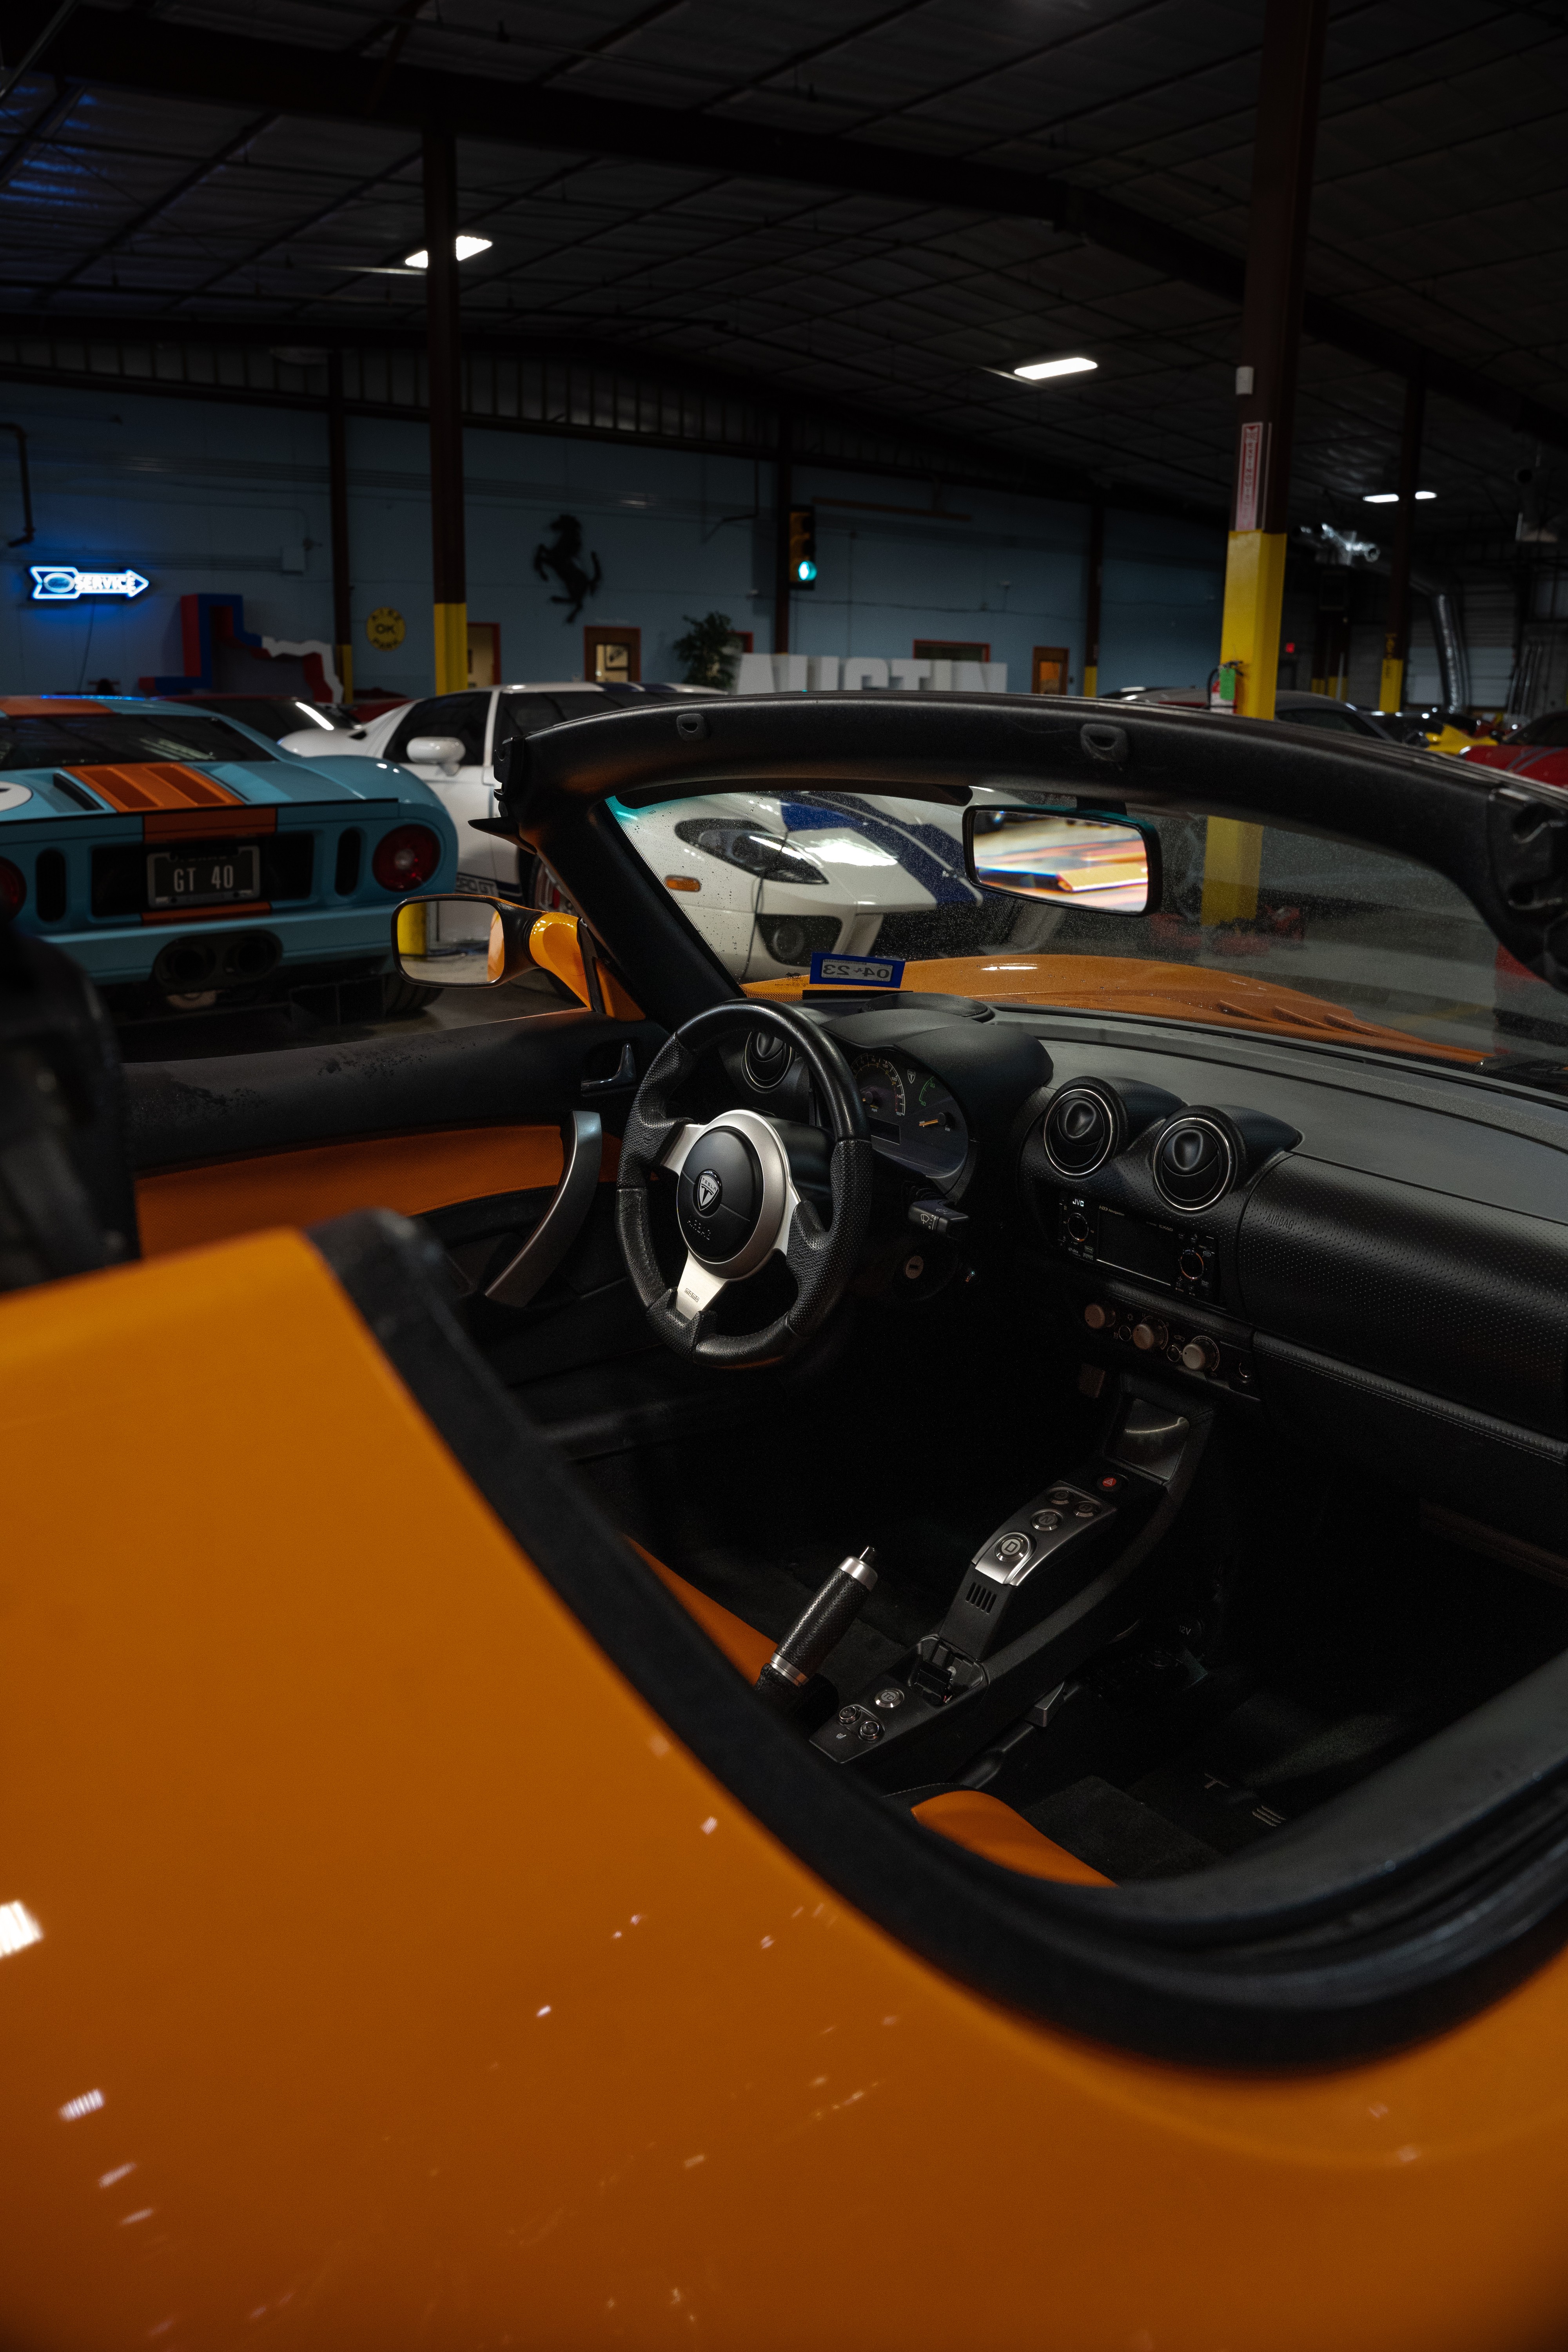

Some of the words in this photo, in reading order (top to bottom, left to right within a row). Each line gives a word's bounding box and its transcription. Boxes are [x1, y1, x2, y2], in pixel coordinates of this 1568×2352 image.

[74, 574, 136, 591] SERVICE
[376, 624, 396, 634] OK
[174, 867, 196, 893] GT
[211, 865, 234, 889] 40
[702, 1177, 717, 1191] TESLA
[1073, 1198, 1084, 1207] JVC
[1265, 1213, 1294, 1230] AIRBAG
[687, 1216, 711, 1240] AIRBAG
[1041, 1515, 1053, 1524] N
[1004, 1541, 1018, 1553] D
[1179, 1625, 1191, 1635] 12V
[883, 1692, 895, 1701] TC
